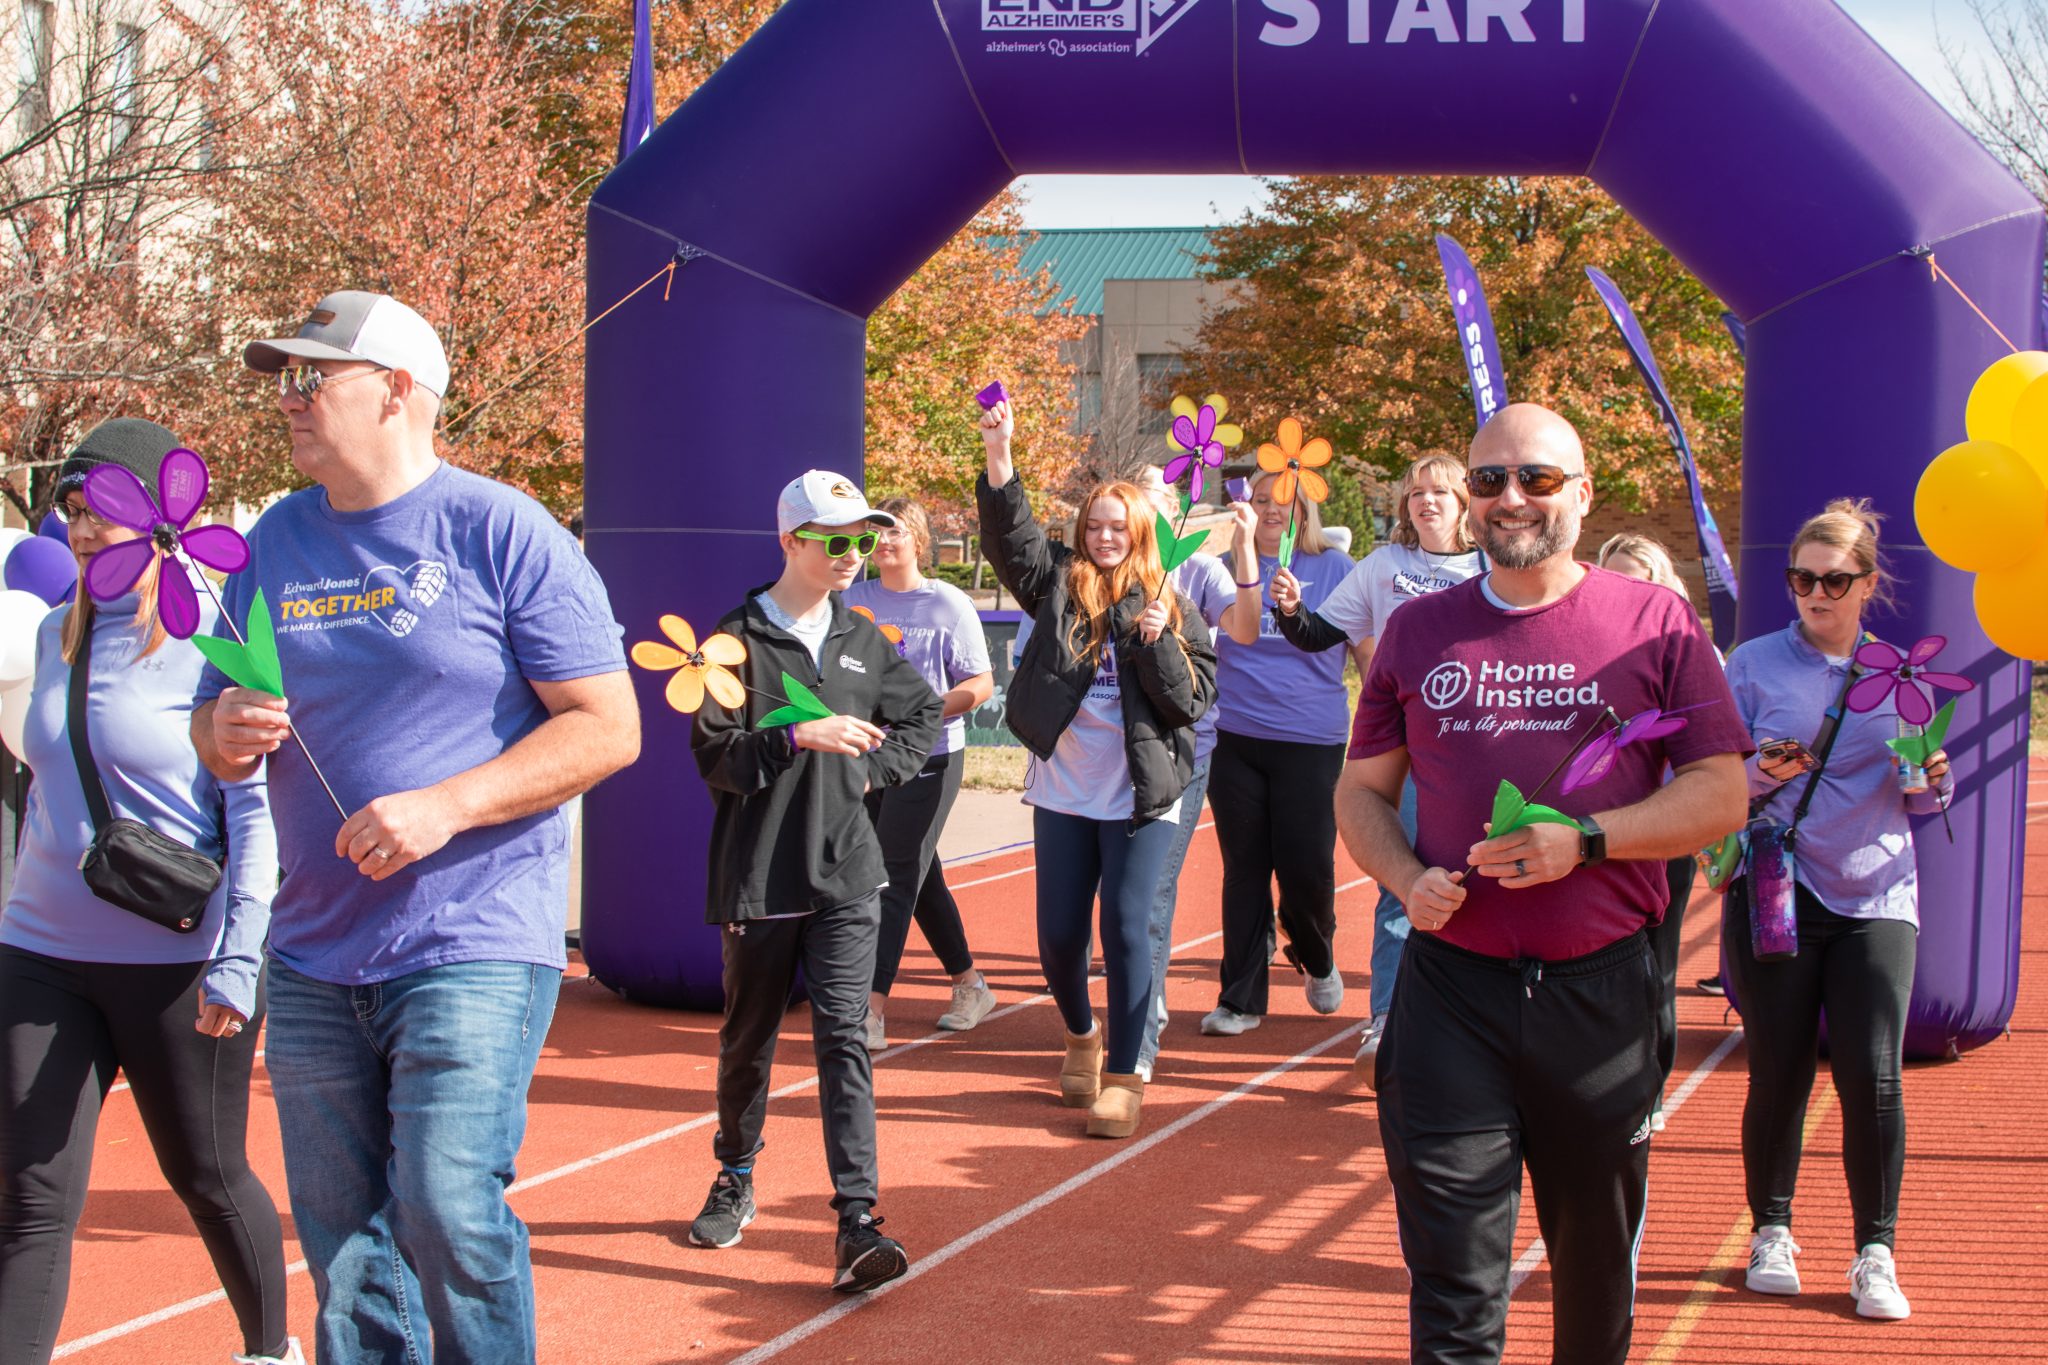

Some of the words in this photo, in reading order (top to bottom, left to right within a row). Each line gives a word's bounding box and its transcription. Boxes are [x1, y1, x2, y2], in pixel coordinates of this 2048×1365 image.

[986, 14, 1124, 28] ALZHEIMER'S
[986, 41, 1046, 53] alzheimer's
[1069, 41, 1130, 53] association
[1466, 321, 1497, 423] RESS
[1433, 578, 1448, 588] TO
[280, 587, 396, 620] TOGETHER
[276, 624, 290, 635] WE
[290, 622, 315, 632] MAKE
[315, 621, 324, 631] A
[1479, 660, 1575, 683] Home
[1090, 692, 1121, 701] ASSOCIA
[1437, 716, 1453, 738] To
[1475, 711, 1498, 732] it's
[1494, 711, 1578, 738] personal
